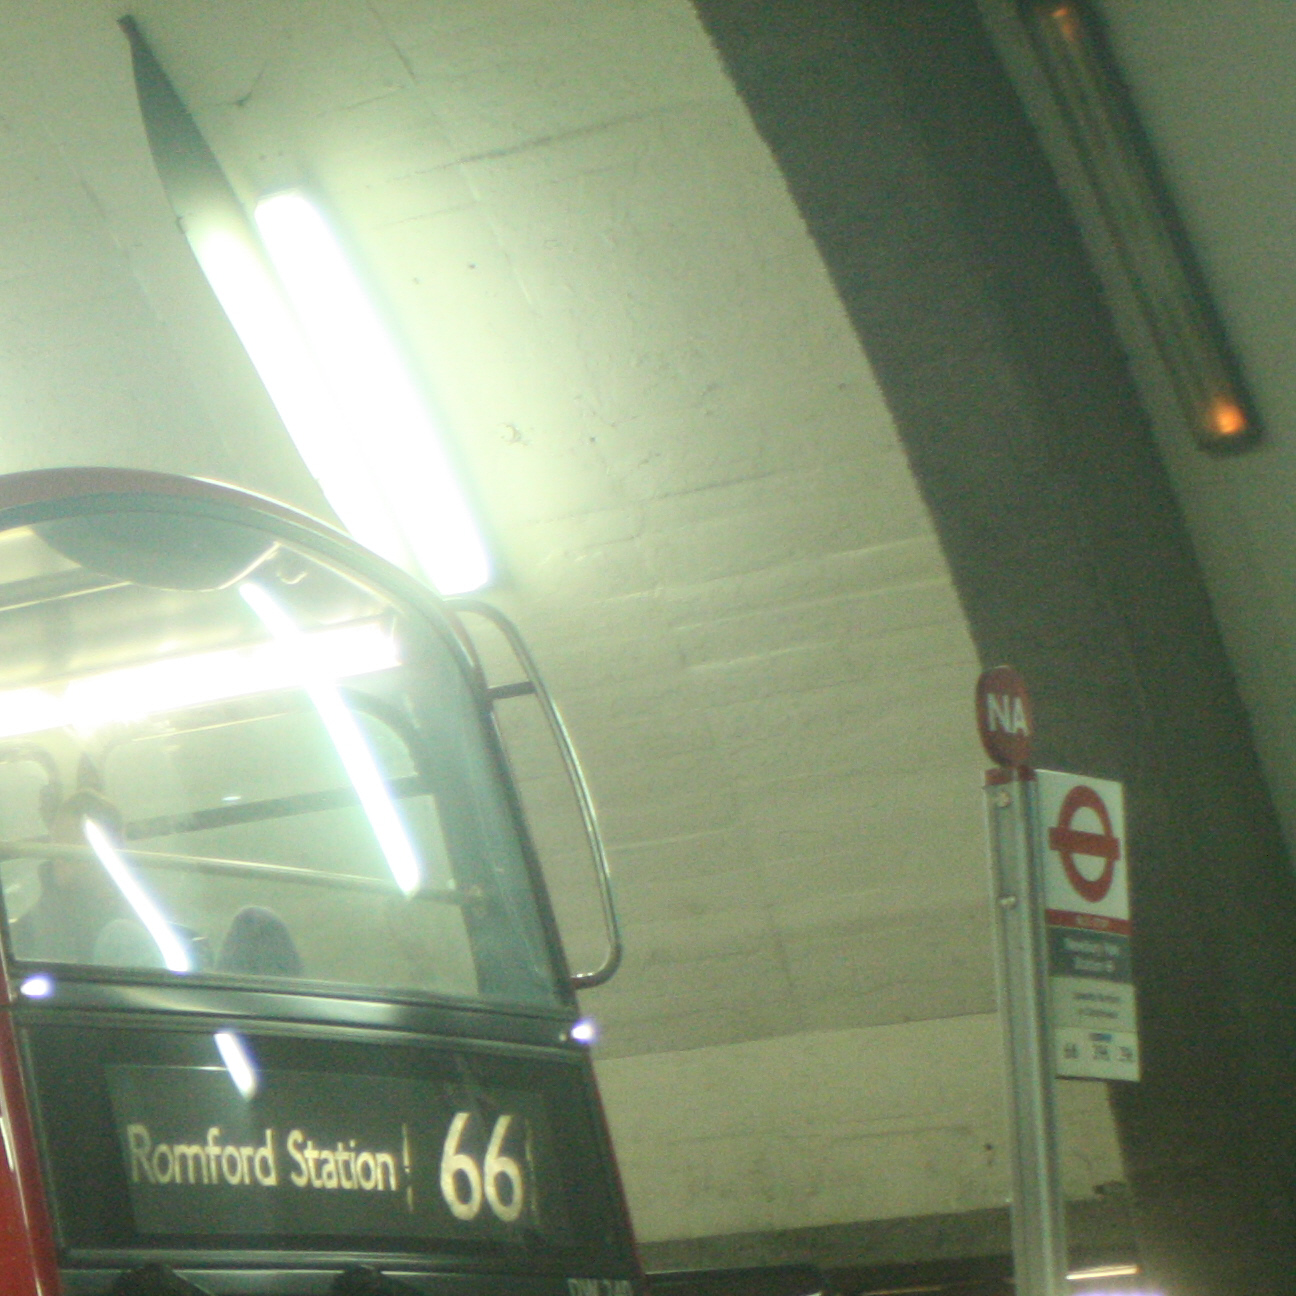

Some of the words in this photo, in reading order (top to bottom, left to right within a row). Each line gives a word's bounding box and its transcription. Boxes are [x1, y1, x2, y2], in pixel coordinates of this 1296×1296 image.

[986, 693, 1031, 736] NA
[126, 1123, 276, 1187] Romford
[287, 1129, 398, 1192] Station
[439, 1111, 524, 1222] 66
